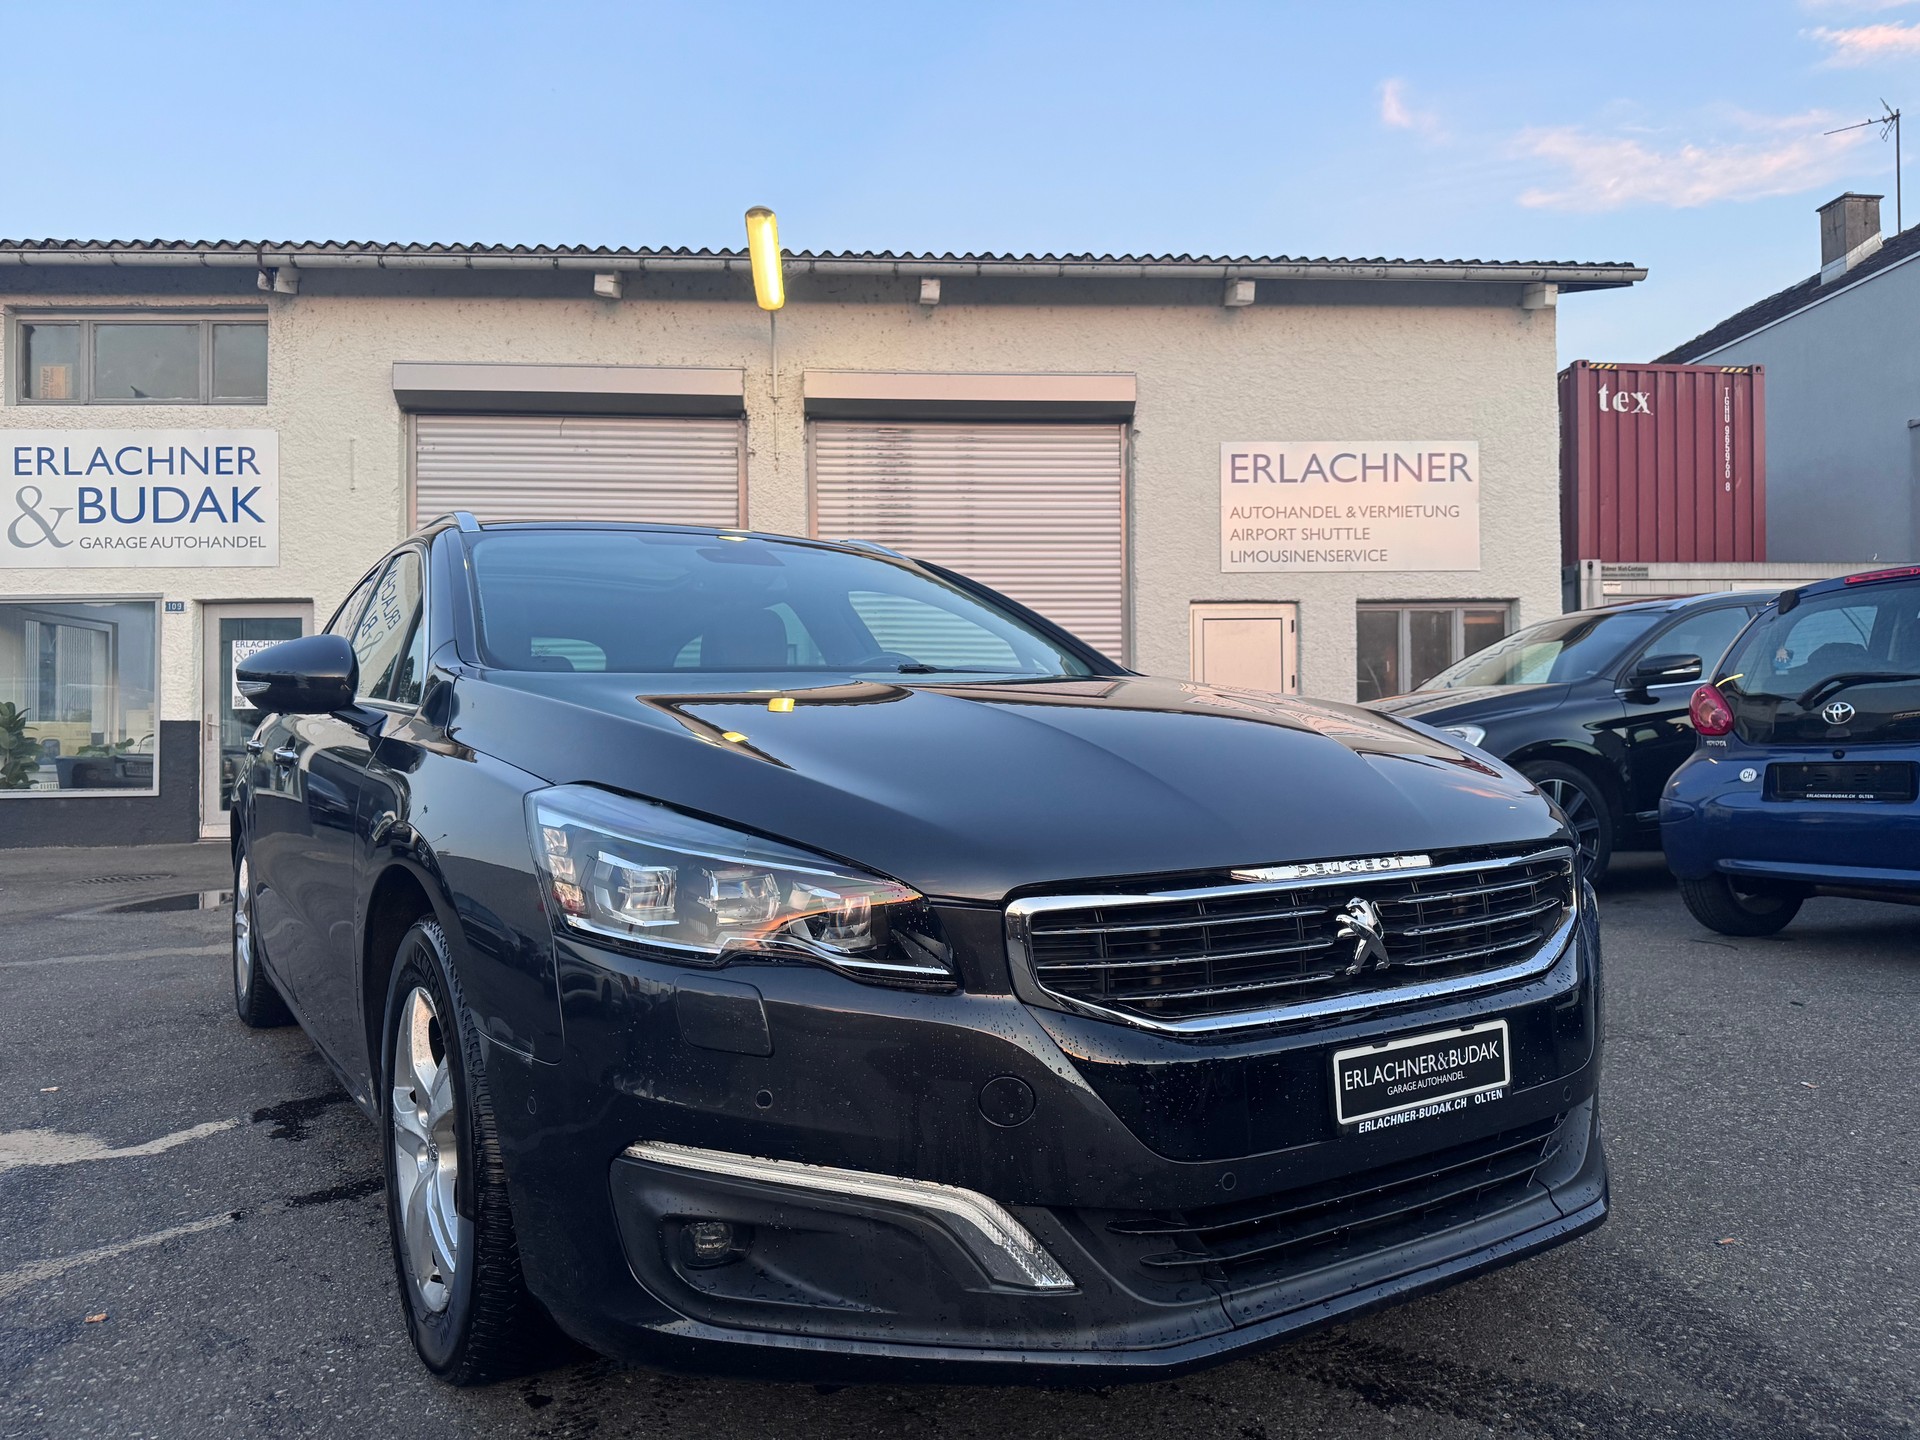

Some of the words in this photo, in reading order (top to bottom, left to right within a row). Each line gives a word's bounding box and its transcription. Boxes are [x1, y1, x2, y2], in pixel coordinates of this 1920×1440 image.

[1598, 383, 1651, 414] tex
[14, 446, 261, 476] ERLACHNER
[1230, 453, 1473, 483] ERLACHNER
[1725, 482, 1731, 492] 8
[7, 485, 74, 549] &
[78, 486, 265, 524] BUDAK
[1229, 506, 1341, 519] AUTOHANDEL
[1346, 506, 1356, 518] &
[1358, 505, 1460, 518] VERMIETUNG
[79, 536, 147, 549] GARAGE
[150, 535, 266, 549] AUTOHANDEL
[1229, 528, 1297, 541] AIRPORT
[1301, 527, 1370, 540] SHUTTLE
[1230, 549, 1388, 563] LIMOUSINENSERVICE
[167, 602, 182, 611] 109
[1743, 770, 1754, 779] CH
[1298, 856, 1404, 877] PEUGEOT
[1387, 1082, 1417, 1096] GARAGE
[1417, 1070, 1466, 1090] AUTOHANDEL
[1358, 1098, 1467, 1134] ERLACHNER-BUDAK.CH
[1474, 1088, 1503, 1105] OLTEN
